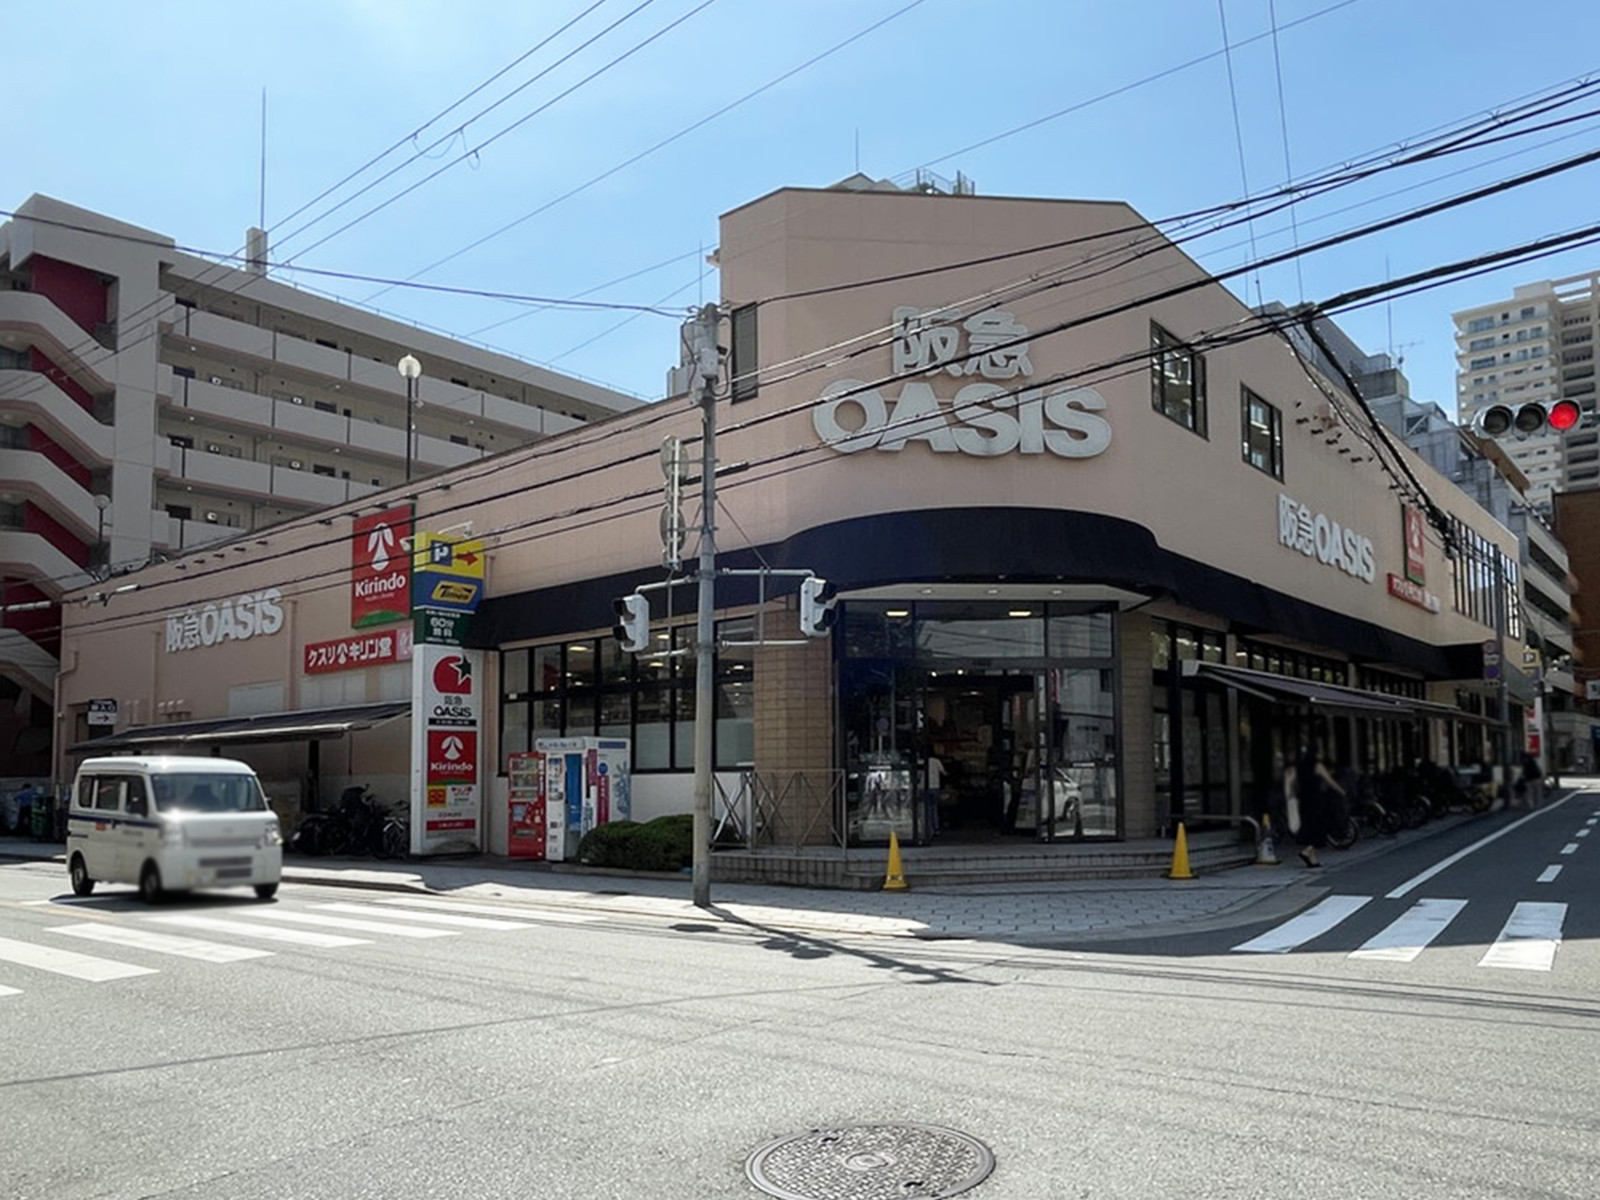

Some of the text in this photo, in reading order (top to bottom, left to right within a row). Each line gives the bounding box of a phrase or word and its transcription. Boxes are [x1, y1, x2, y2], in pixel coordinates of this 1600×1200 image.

[892, 306, 1033, 379] 阪急
[813, 379, 1112, 459] OASIS
[434, 543, 449, 562] P
[1278, 493, 1377, 585] 阪急OASIS
[355, 572, 407, 598] Kirindo
[440, 585, 473, 600] Times
[166, 587, 284, 653] 阪急OASIS
[308, 645, 336, 667] クスリ
[349, 636, 393, 661] キリン堂
[434, 705, 472, 717] OASIS
[430, 762, 473, 771] Kirindo
